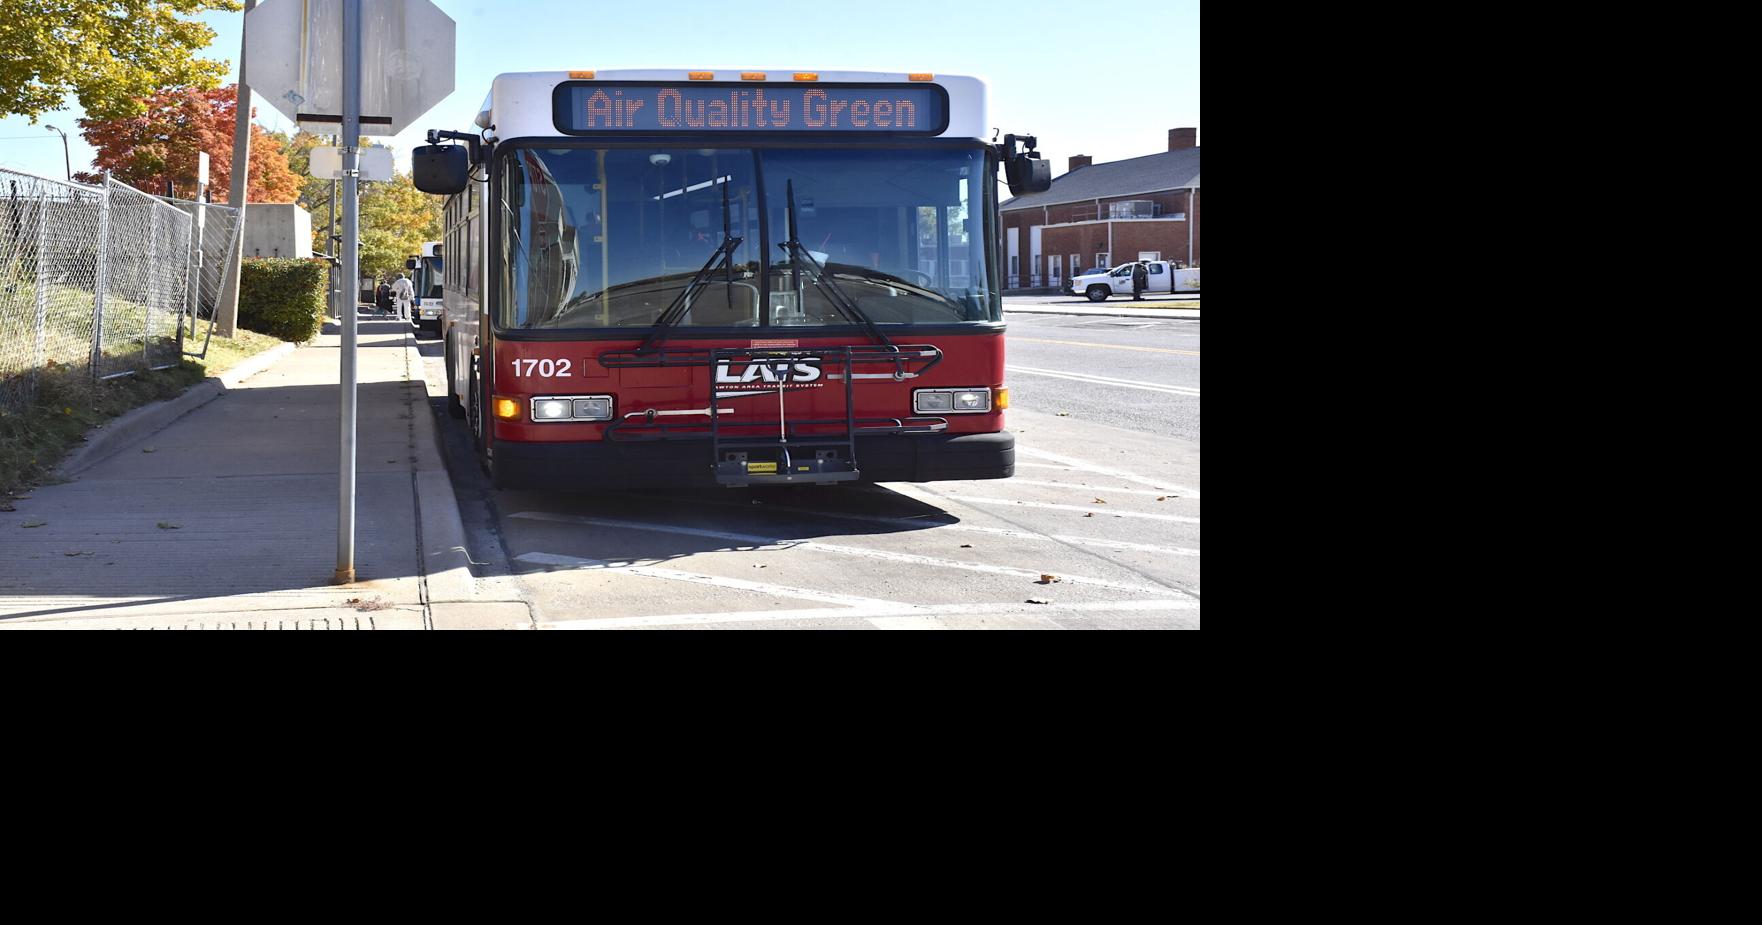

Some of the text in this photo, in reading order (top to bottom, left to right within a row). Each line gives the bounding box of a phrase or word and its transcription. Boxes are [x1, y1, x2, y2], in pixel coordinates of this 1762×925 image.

[587, 88, 915, 128] Air Quality Green
[511, 358, 572, 378] 1702
